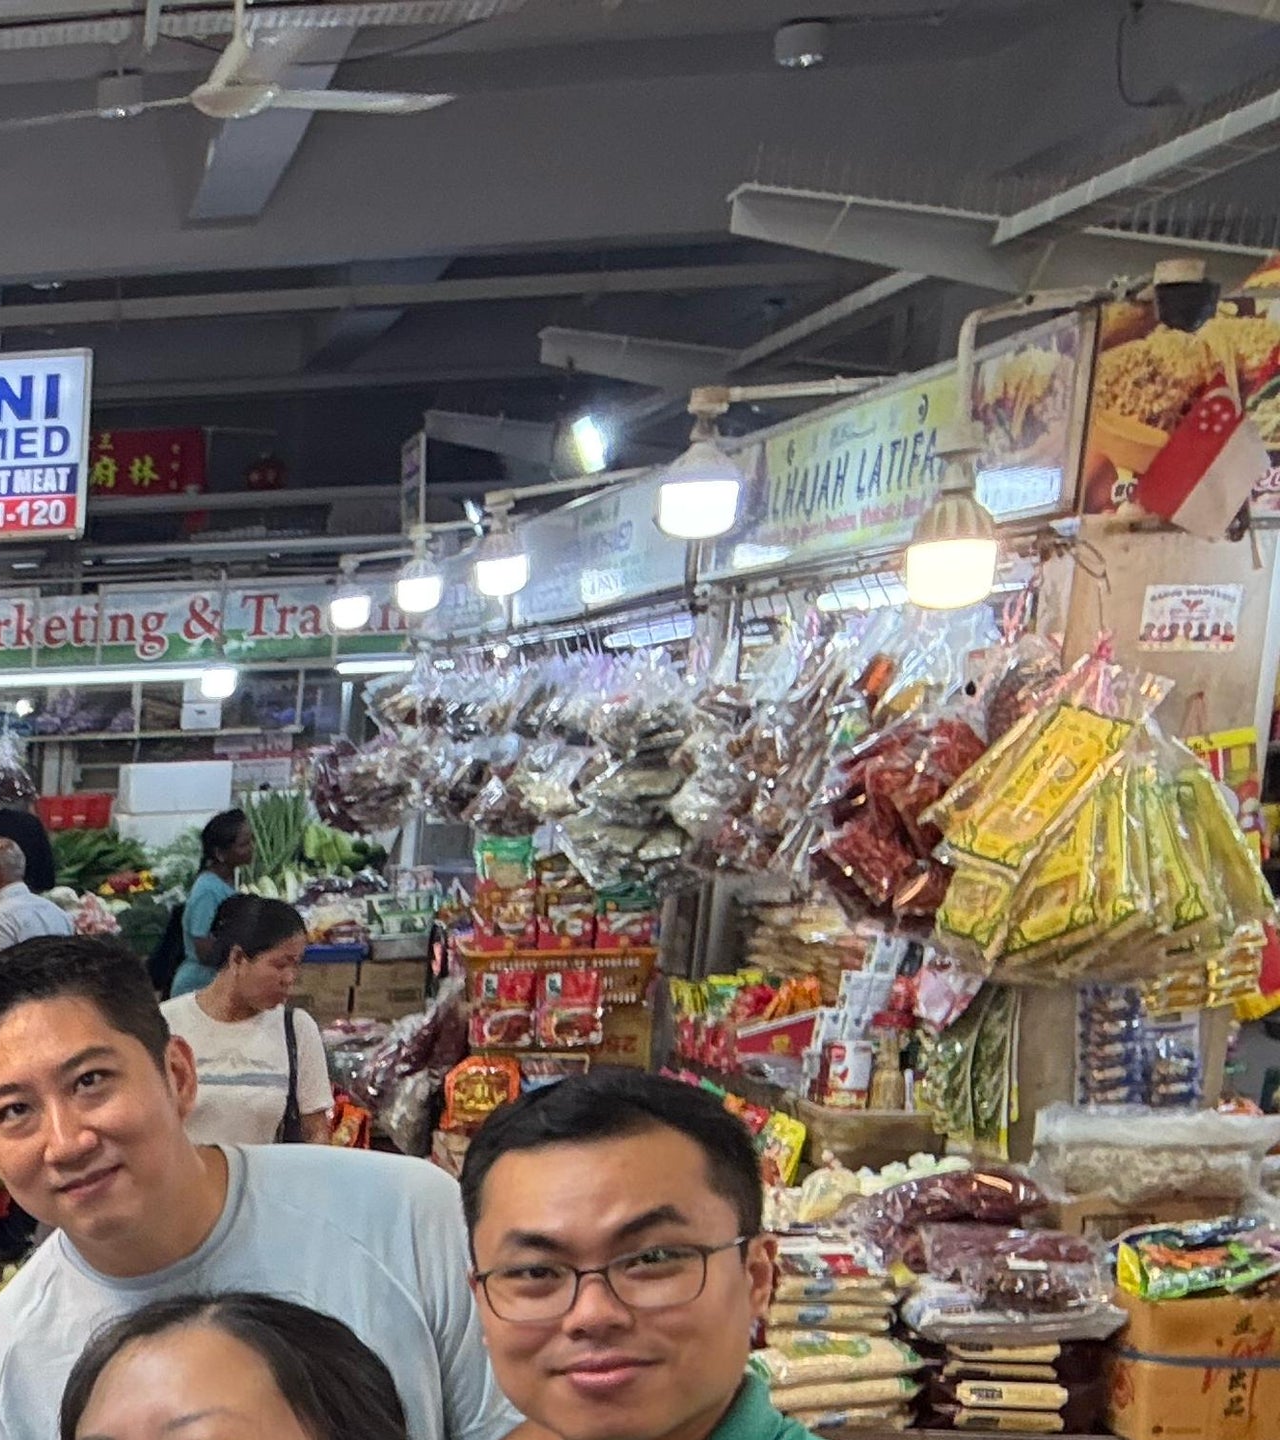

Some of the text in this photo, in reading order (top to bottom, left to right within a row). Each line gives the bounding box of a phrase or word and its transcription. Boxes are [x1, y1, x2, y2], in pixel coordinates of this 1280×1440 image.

[12, 467, 70, 493] MEAT
[856, 428, 944, 500] LATIFA
[184, 597, 223, 640] &
